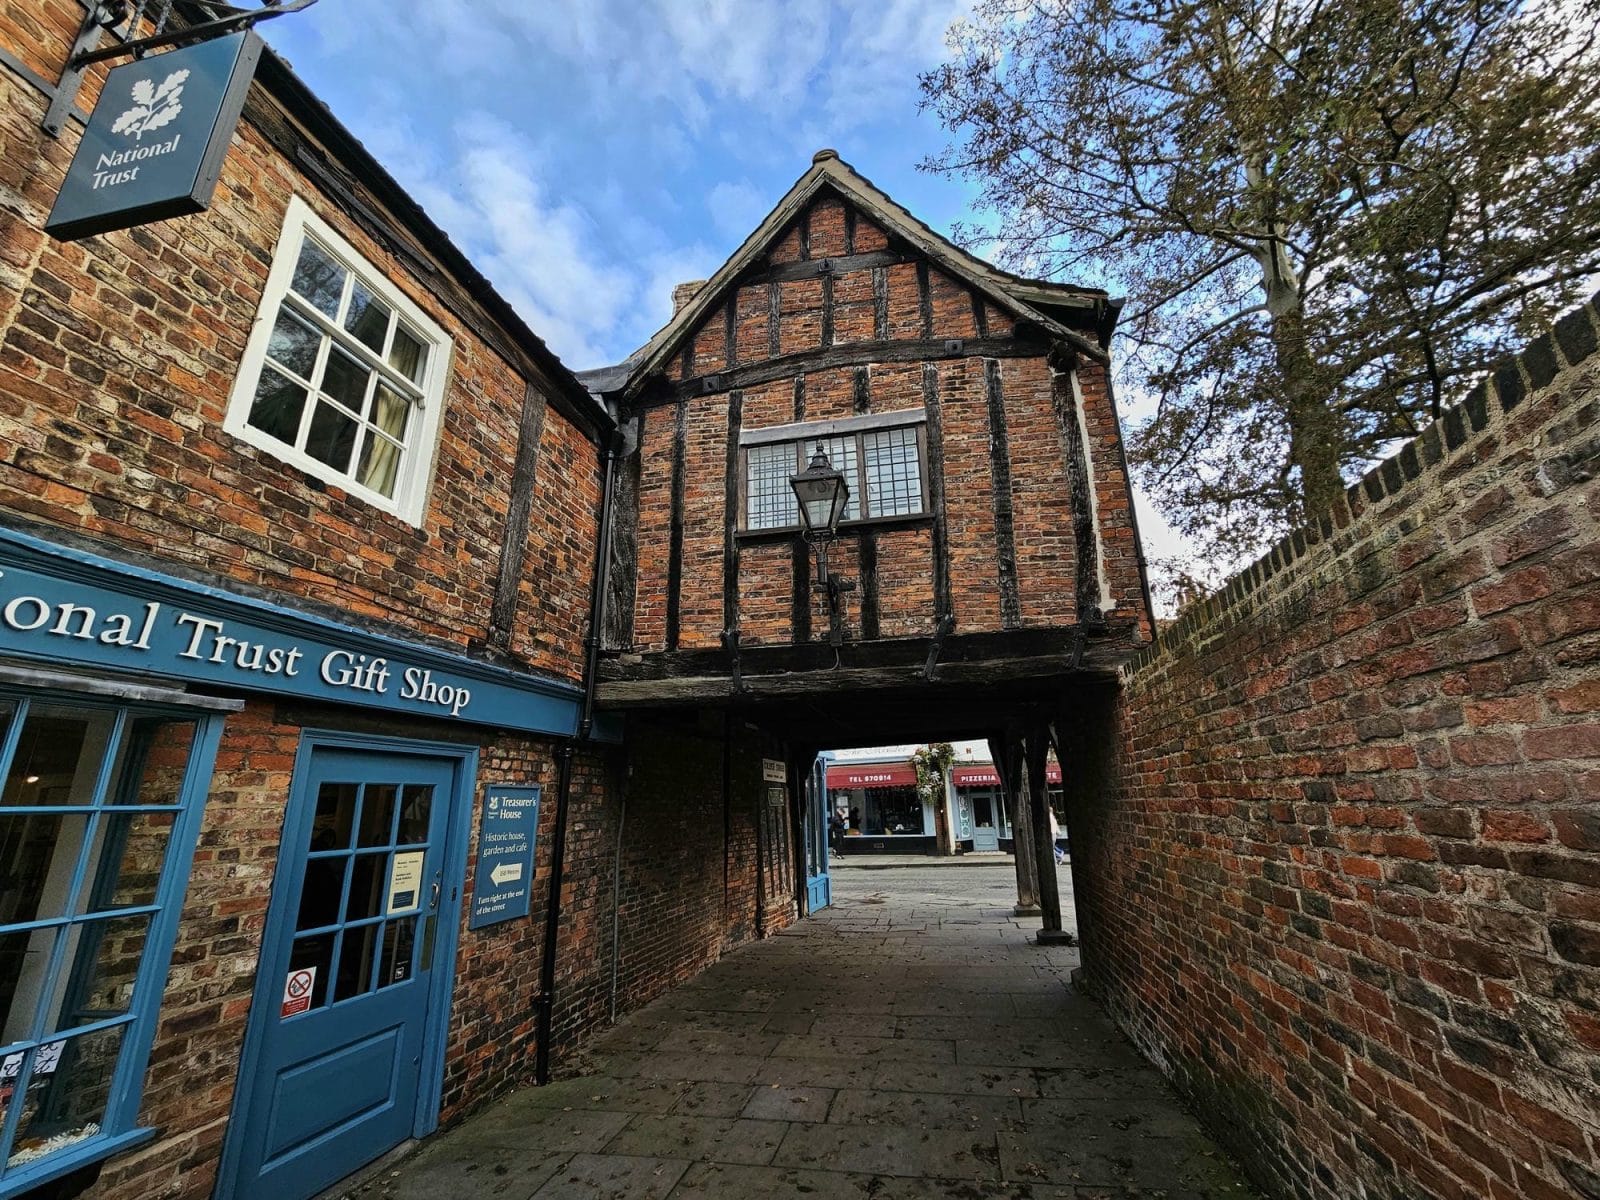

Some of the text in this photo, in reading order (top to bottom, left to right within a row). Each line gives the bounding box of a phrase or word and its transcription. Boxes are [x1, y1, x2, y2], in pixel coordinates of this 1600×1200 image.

[96, 134, 181, 171] National
[92, 166, 140, 190] Trust
[0, 570, 471, 716] onal Trust Gift Shop
[960, 774, 997, 782] PIZZERIA
[501, 796, 537, 807] Treasurer's
[499, 808, 522, 819] House
[485, 832, 508, 841] Historic
[482, 845, 504, 858] garden
[504, 843, 516, 853] and
[507, 890, 516, 899] the
[515, 888, 525, 897] end
